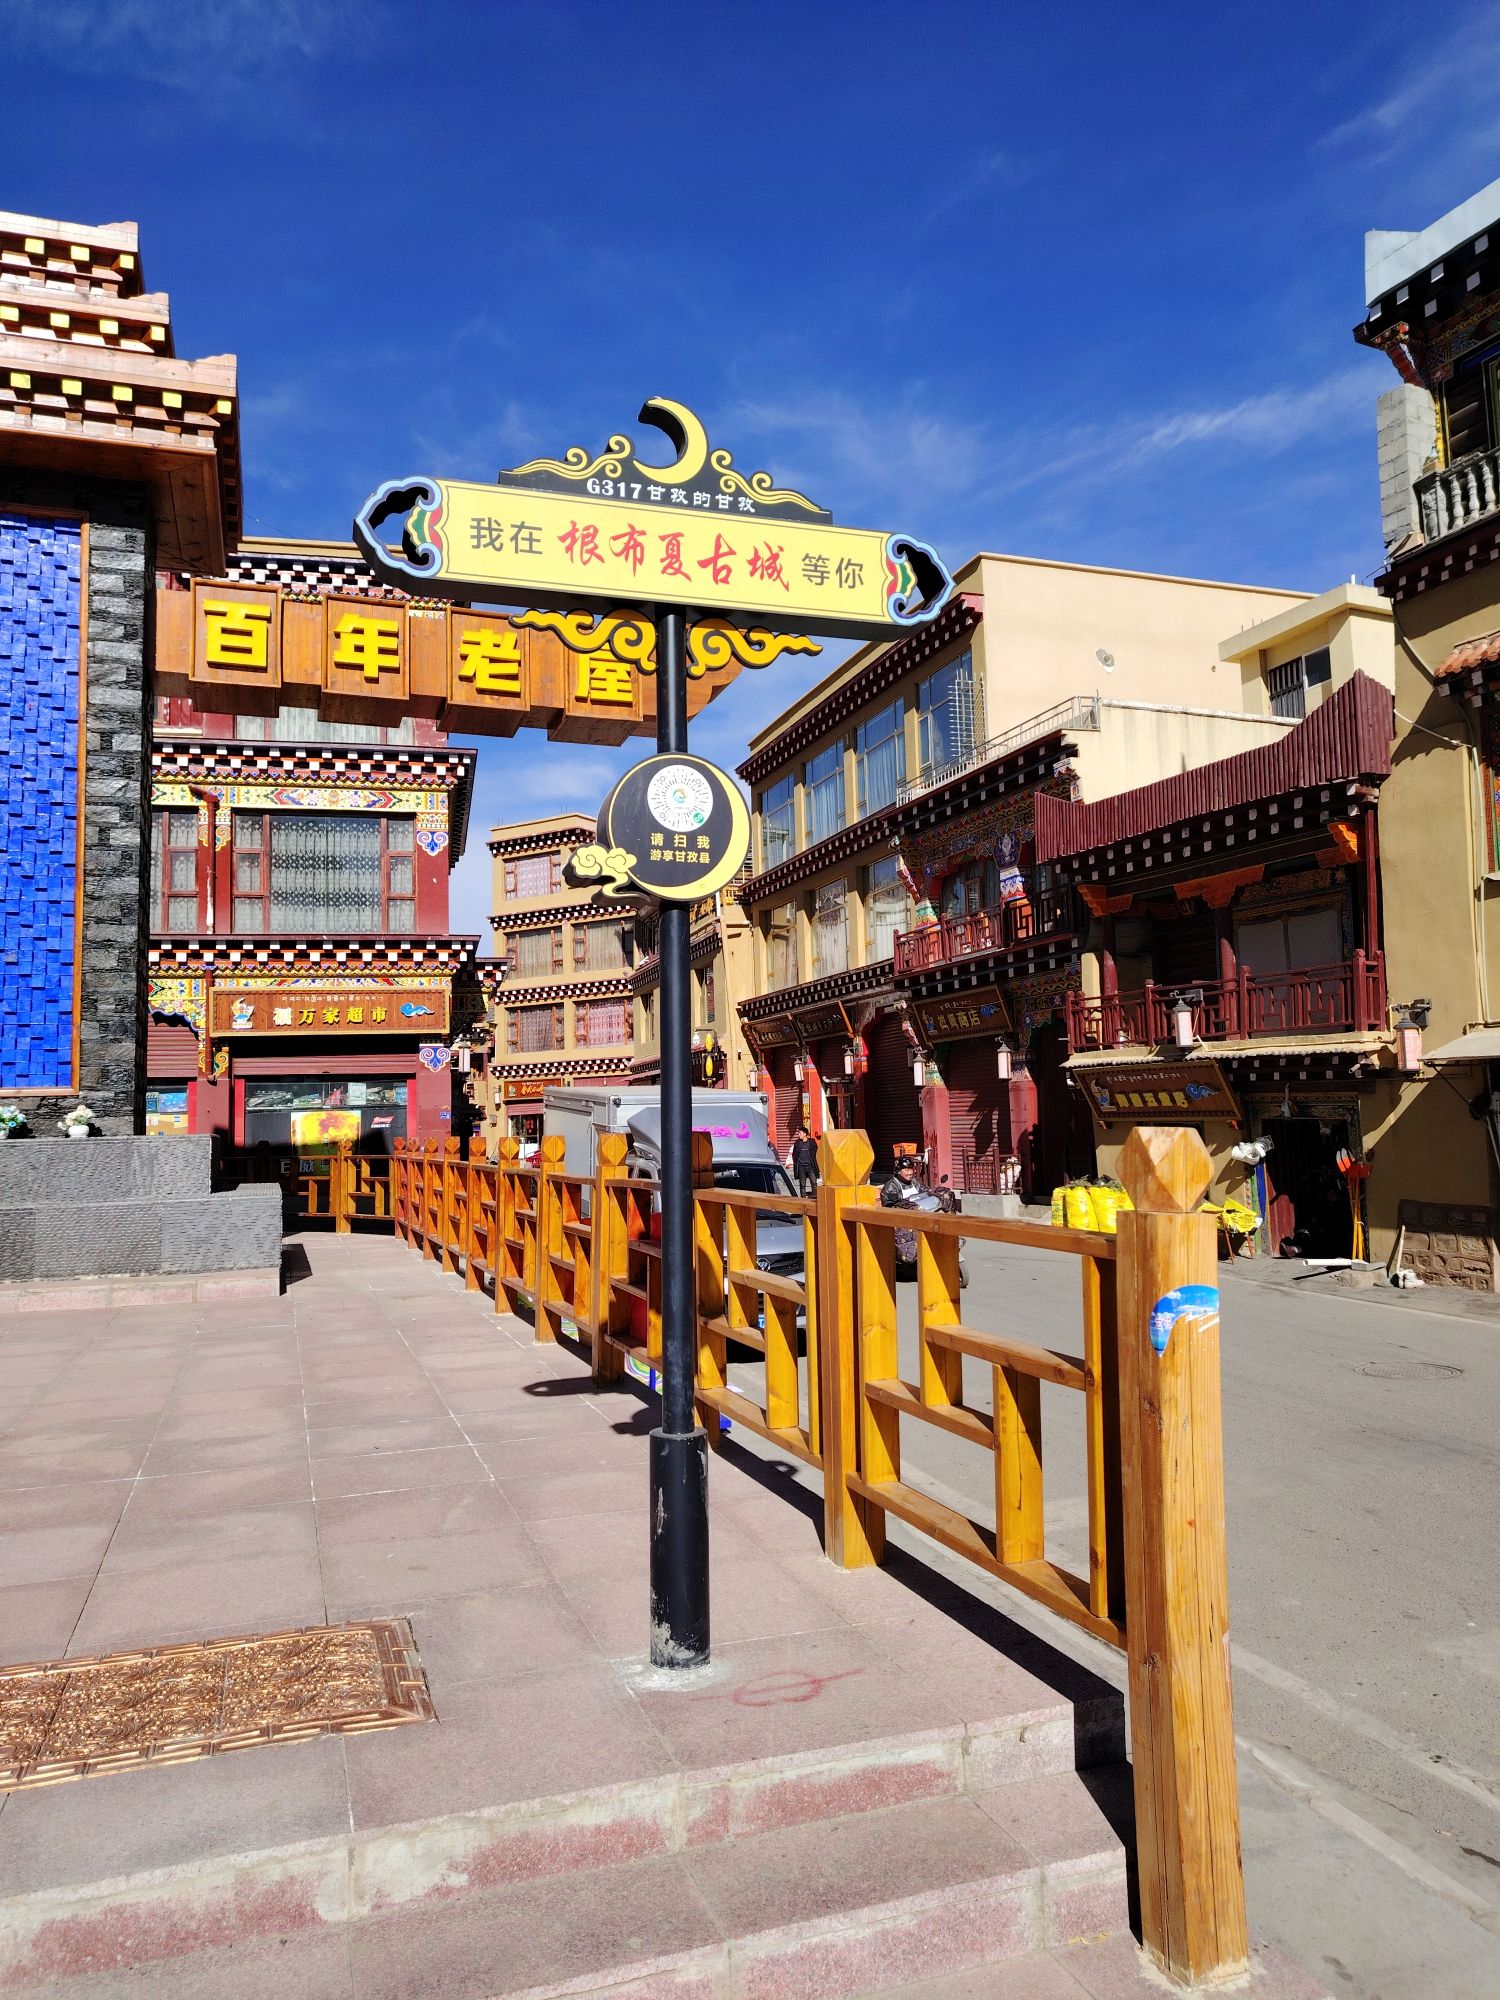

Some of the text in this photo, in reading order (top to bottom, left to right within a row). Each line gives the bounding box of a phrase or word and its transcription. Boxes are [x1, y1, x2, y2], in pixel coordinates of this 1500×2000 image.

[203, 599, 633, 703] 百年老屋
[651, 833, 710, 848] 请扫我
[650, 849, 710, 863] 游享甘孜县
[272, 1006, 389, 1027] 福万家超市
